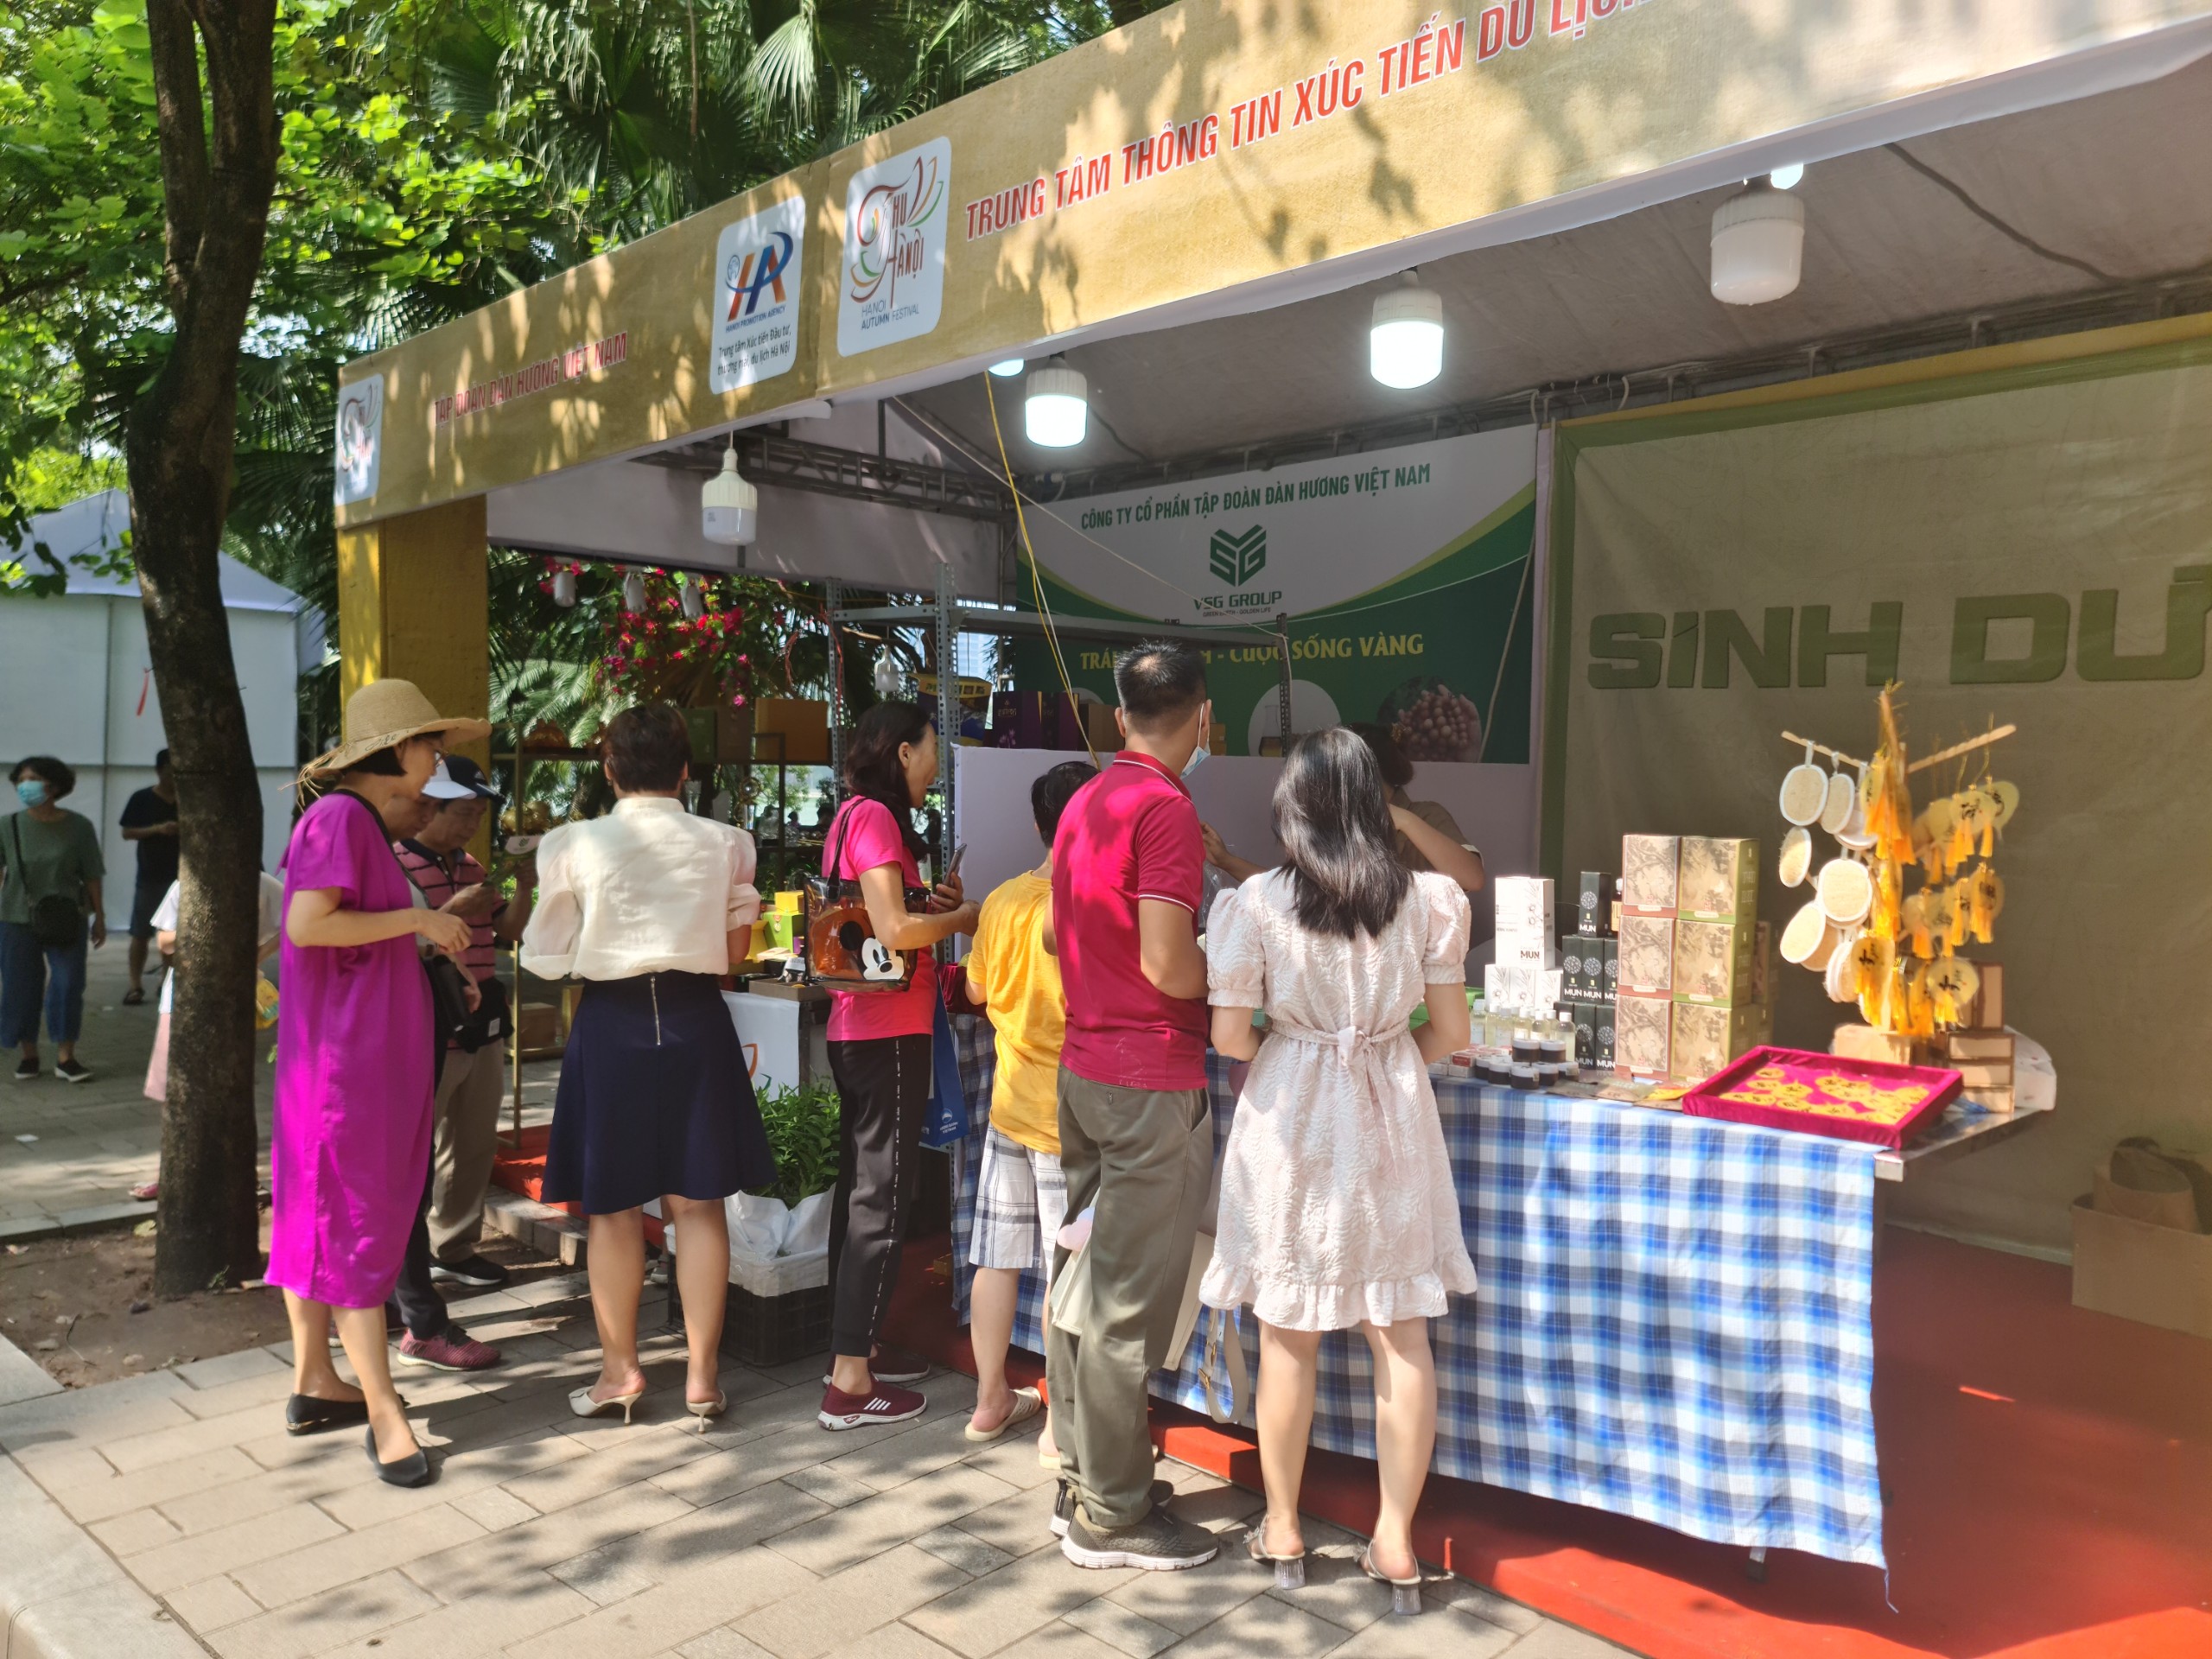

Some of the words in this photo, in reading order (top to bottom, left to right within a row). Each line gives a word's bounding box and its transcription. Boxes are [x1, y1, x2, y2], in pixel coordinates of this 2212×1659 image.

[965, 177, 1046, 242] TRUNG
[1053, 152, 1112, 210] TÂM
[1120, 112, 1219, 187] THÔNG
[1229, 89, 1282, 150] TIN
[1292, 54, 1365, 129] XÚC
[1377, 10, 1466, 98] TIẾN
[1478, 0, 1535, 62] DU
[861, 298, 887, 318] HANOI
[861, 312, 890, 331] AUTUMN
[891, 302, 920, 322] FESTIVAL
[747, 335, 757, 348] Xúc
[563, 341, 591, 385] VIỆT
[594, 330, 628, 372] NAM
[751, 353, 759, 365] du
[1081, 508, 1113, 530] CÔNG
[1116, 507, 1132, 524] TY
[1135, 496, 1153, 522] CỔ
[1155, 493, 1190, 520] PHẦN
[1194, 492, 1219, 518] TẬP
[1223, 486, 1261, 511] ĐOÀN
[1265, 480, 1294, 505] ĐÀN
[1299, 475, 1350, 501] HƯƠNG
[1354, 467, 1390, 497] VIỆT
[1395, 463, 1431, 487] NAM
[1193, 595, 1224, 611] VSG
[1229, 590, 1282, 607] GROUP
[1291, 632, 1351, 660] SỐNG
[1361, 631, 1424, 657] VÀNG
[1587, 601, 1903, 690] SINH
[1579, 924, 1597, 933] MUN
[1520, 950, 1541, 960] MUN
[1564, 988, 1583, 997] MUN
[1583, 990, 1602, 1000] MUN
[1575, 1057, 1593, 1067] MUN
[1596, 1059, 1616, 1069] MUN
